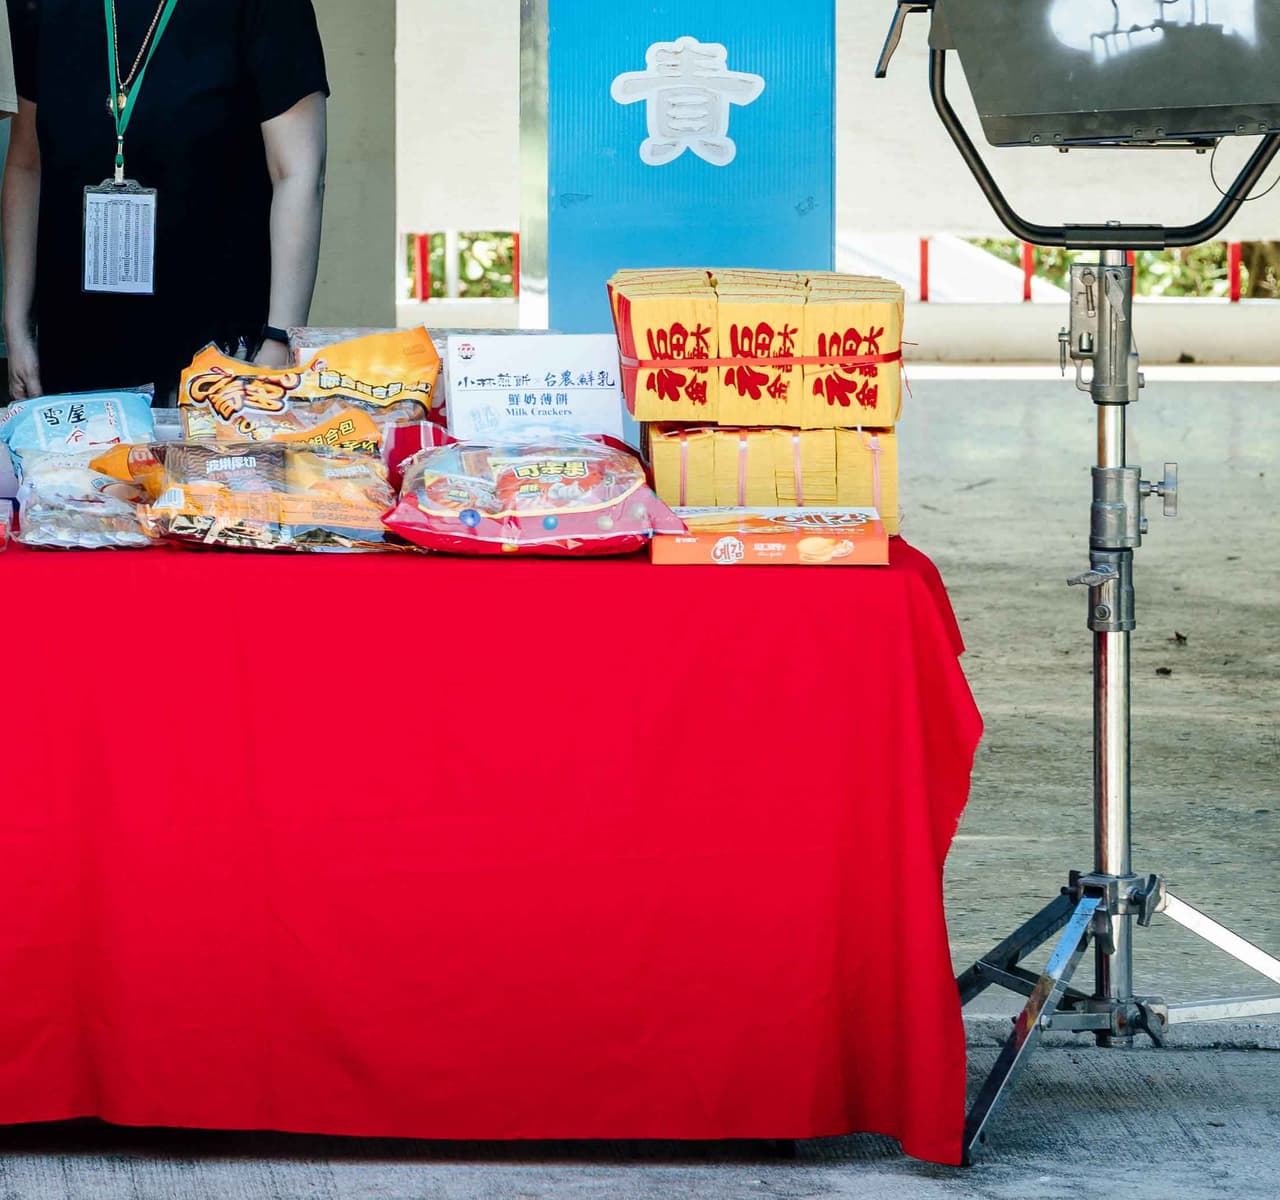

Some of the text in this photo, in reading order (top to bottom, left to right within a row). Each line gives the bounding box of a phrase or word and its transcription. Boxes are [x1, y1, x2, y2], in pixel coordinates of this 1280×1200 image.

[646, 321, 689, 402] 福
[724, 321, 775, 400] 福
[812, 325, 863, 407] 福
[457, 369, 616, 388] 小林煎餅 台農鮮乳
[508, 392, 569, 406] 鮮奶薄餅
[43, 404, 89, 426] 雪屋
[505, 407, 573, 416] Milk Crackers
